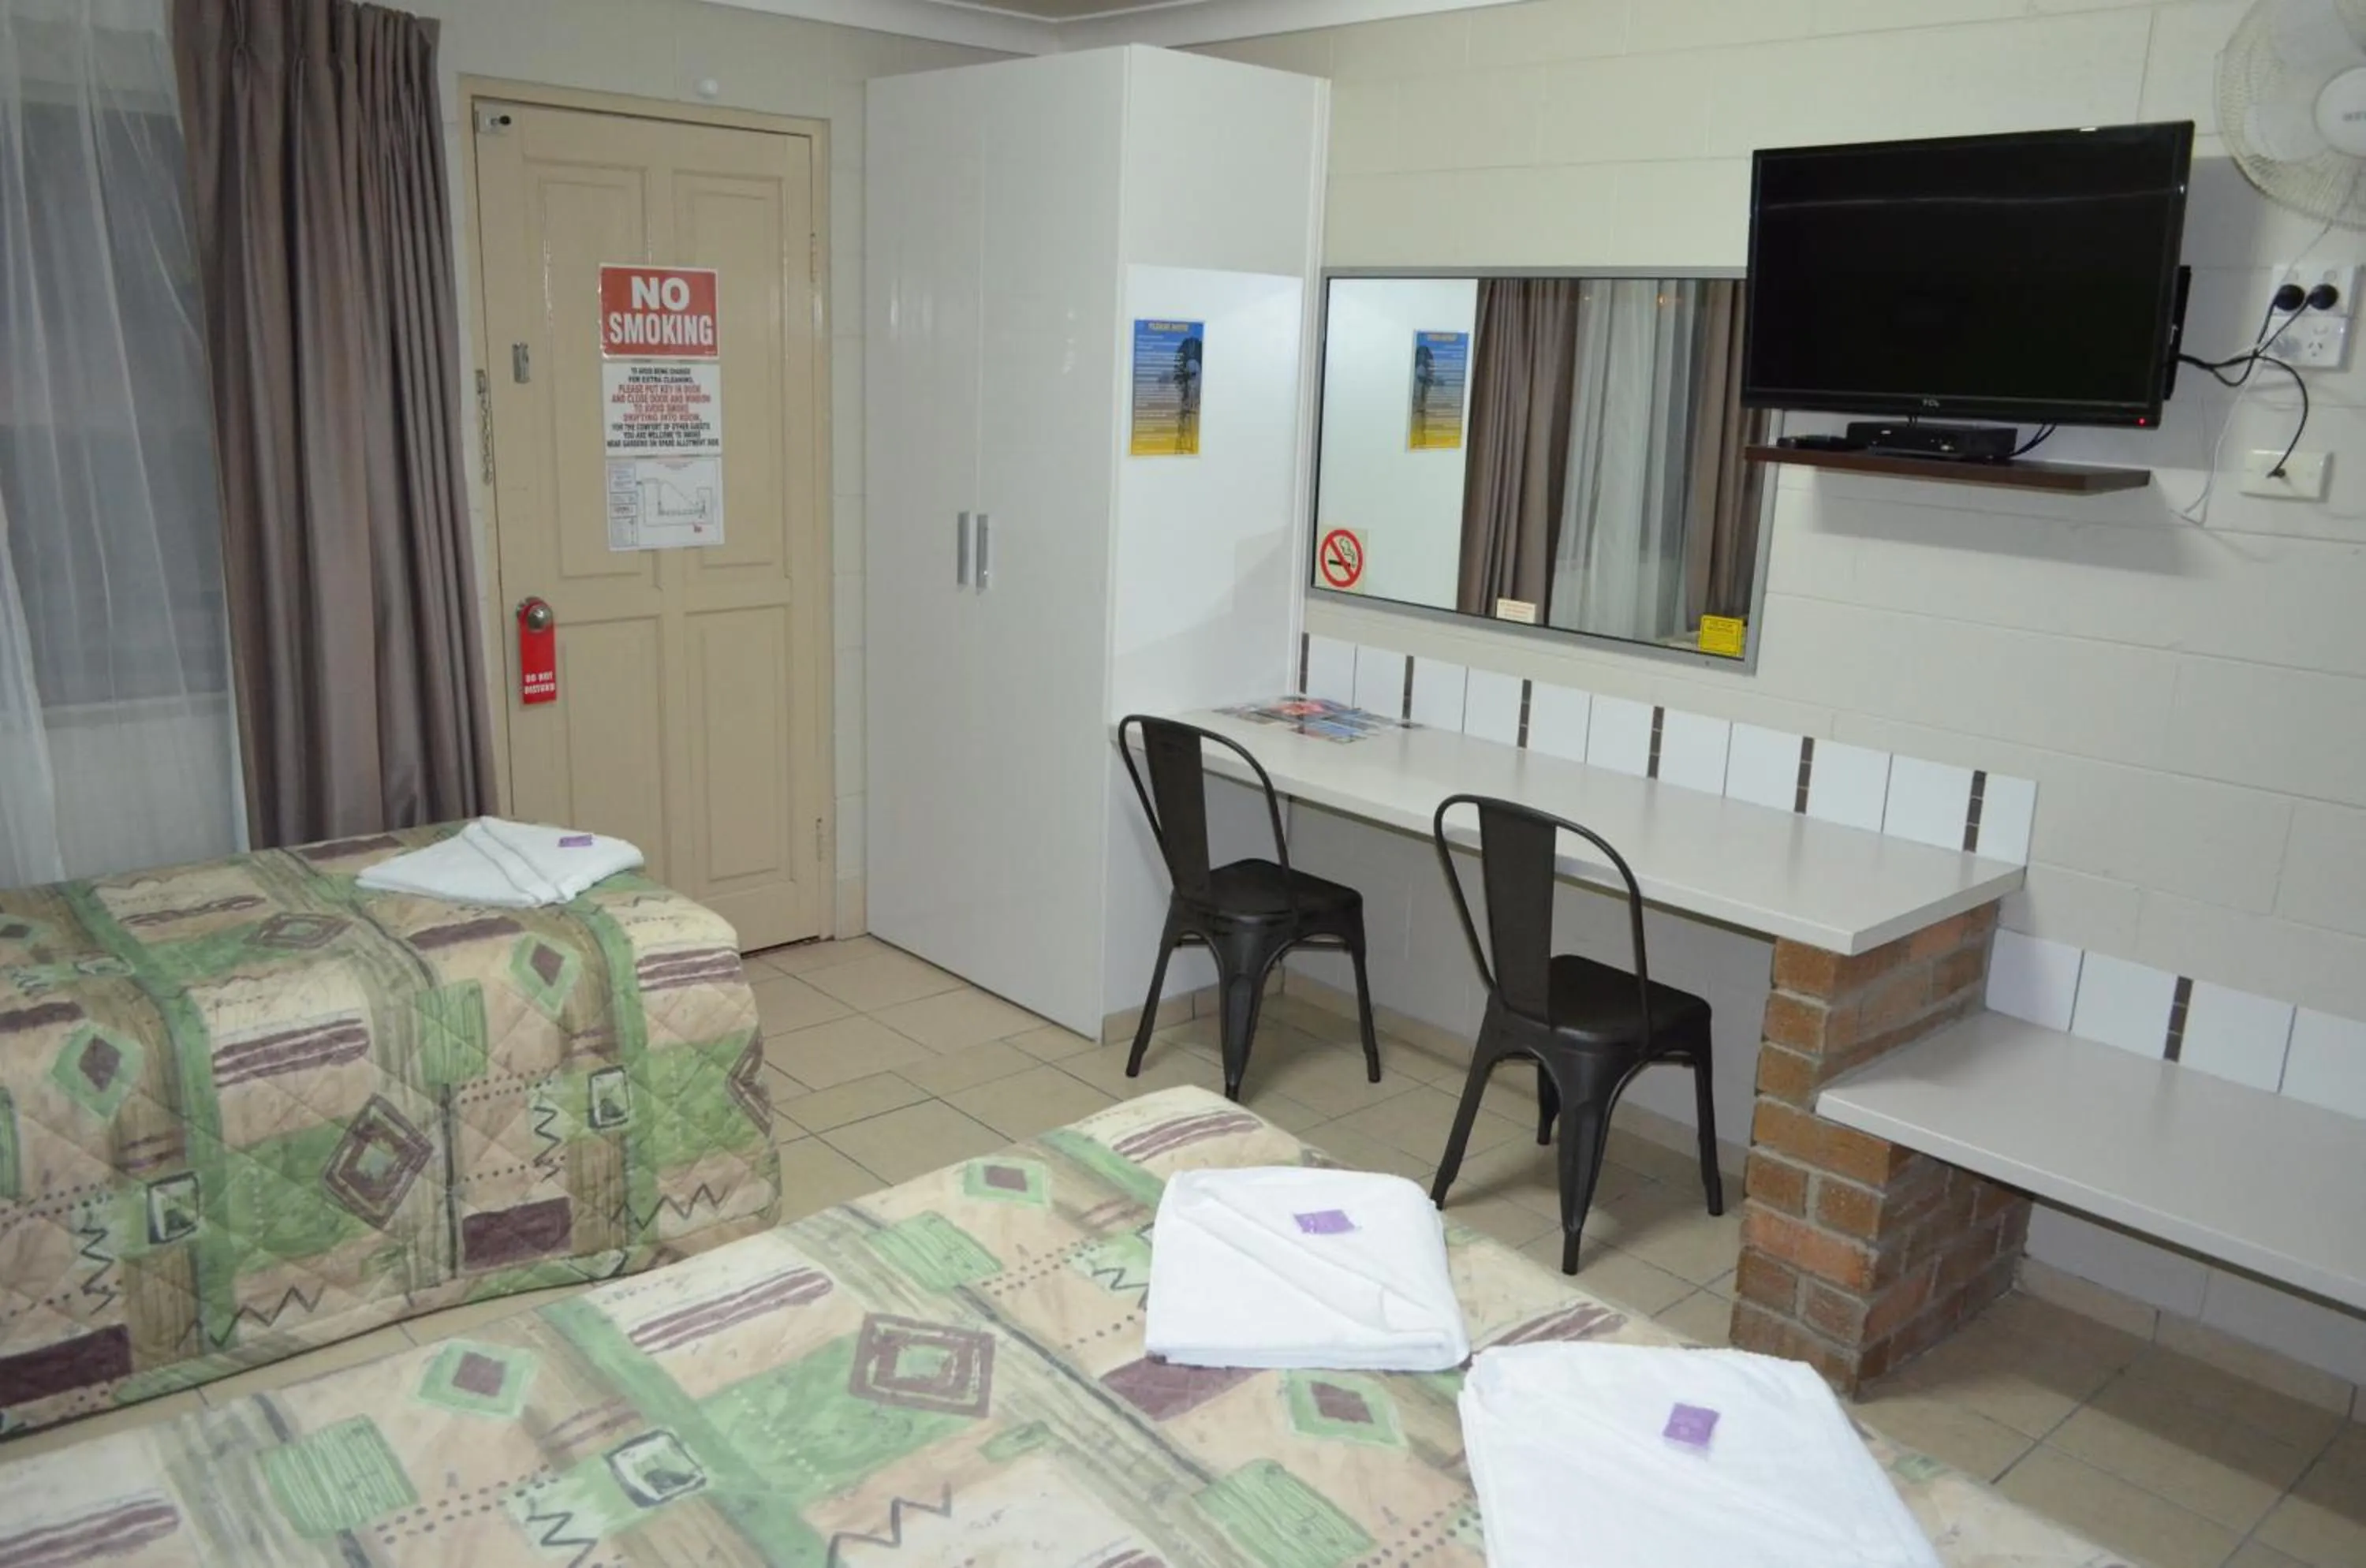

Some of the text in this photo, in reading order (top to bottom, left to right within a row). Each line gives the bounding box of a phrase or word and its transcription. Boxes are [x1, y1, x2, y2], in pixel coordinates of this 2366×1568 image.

[632, 276, 690, 311] NO
[609, 312, 713, 345] SMOKING
[611, 394, 626, 403] AND
[627, 394, 648, 403] CLOSE
[1921, 398, 1939, 408] TCL
[524, 670, 553, 683] DO NOT
[524, 683, 555, 694] DISTURB
